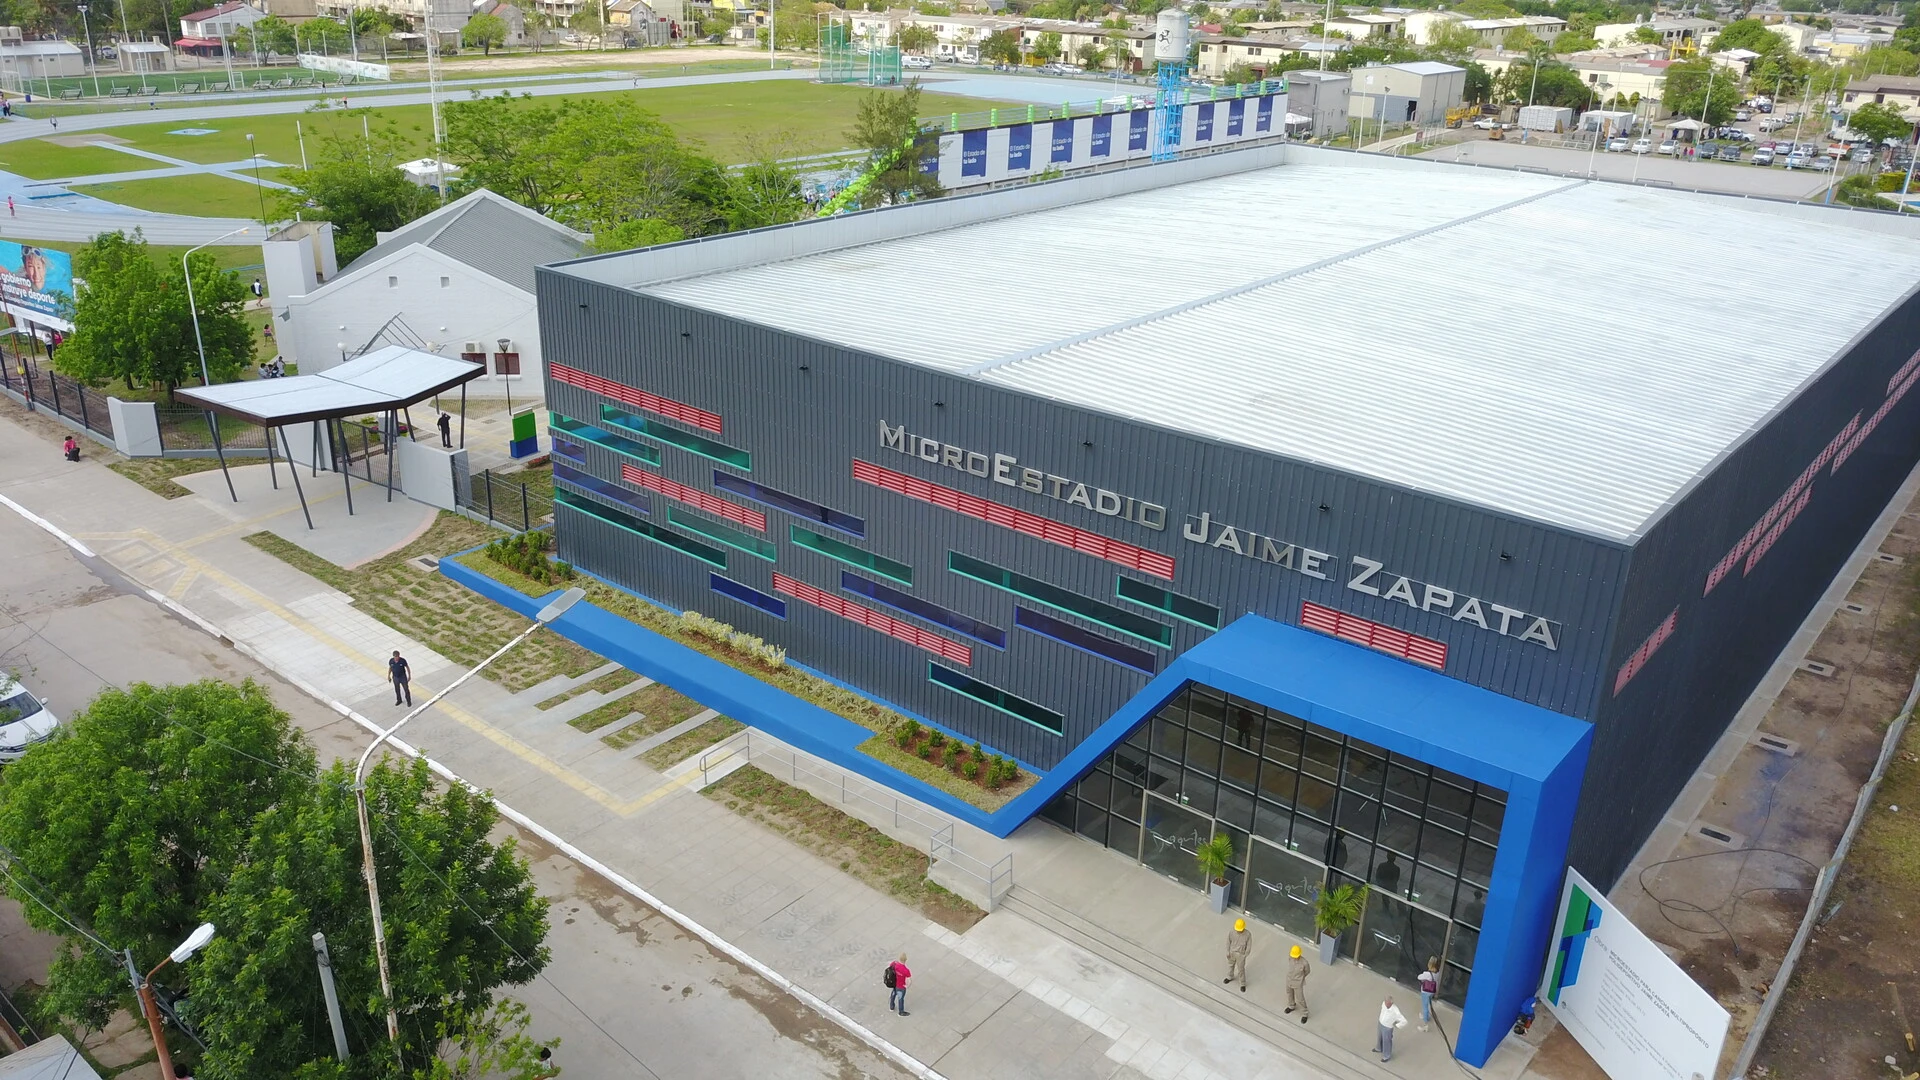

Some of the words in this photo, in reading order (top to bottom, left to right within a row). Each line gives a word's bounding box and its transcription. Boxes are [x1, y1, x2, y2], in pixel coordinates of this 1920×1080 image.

[1, 272, 32, 288] gobierno
[28, 288, 56, 304] deporte
[879, 419, 1166, 531] MICROESTADIO
[1184, 512, 1329, 580] JAIME
[1347, 555, 1558, 650] ZAPATA
